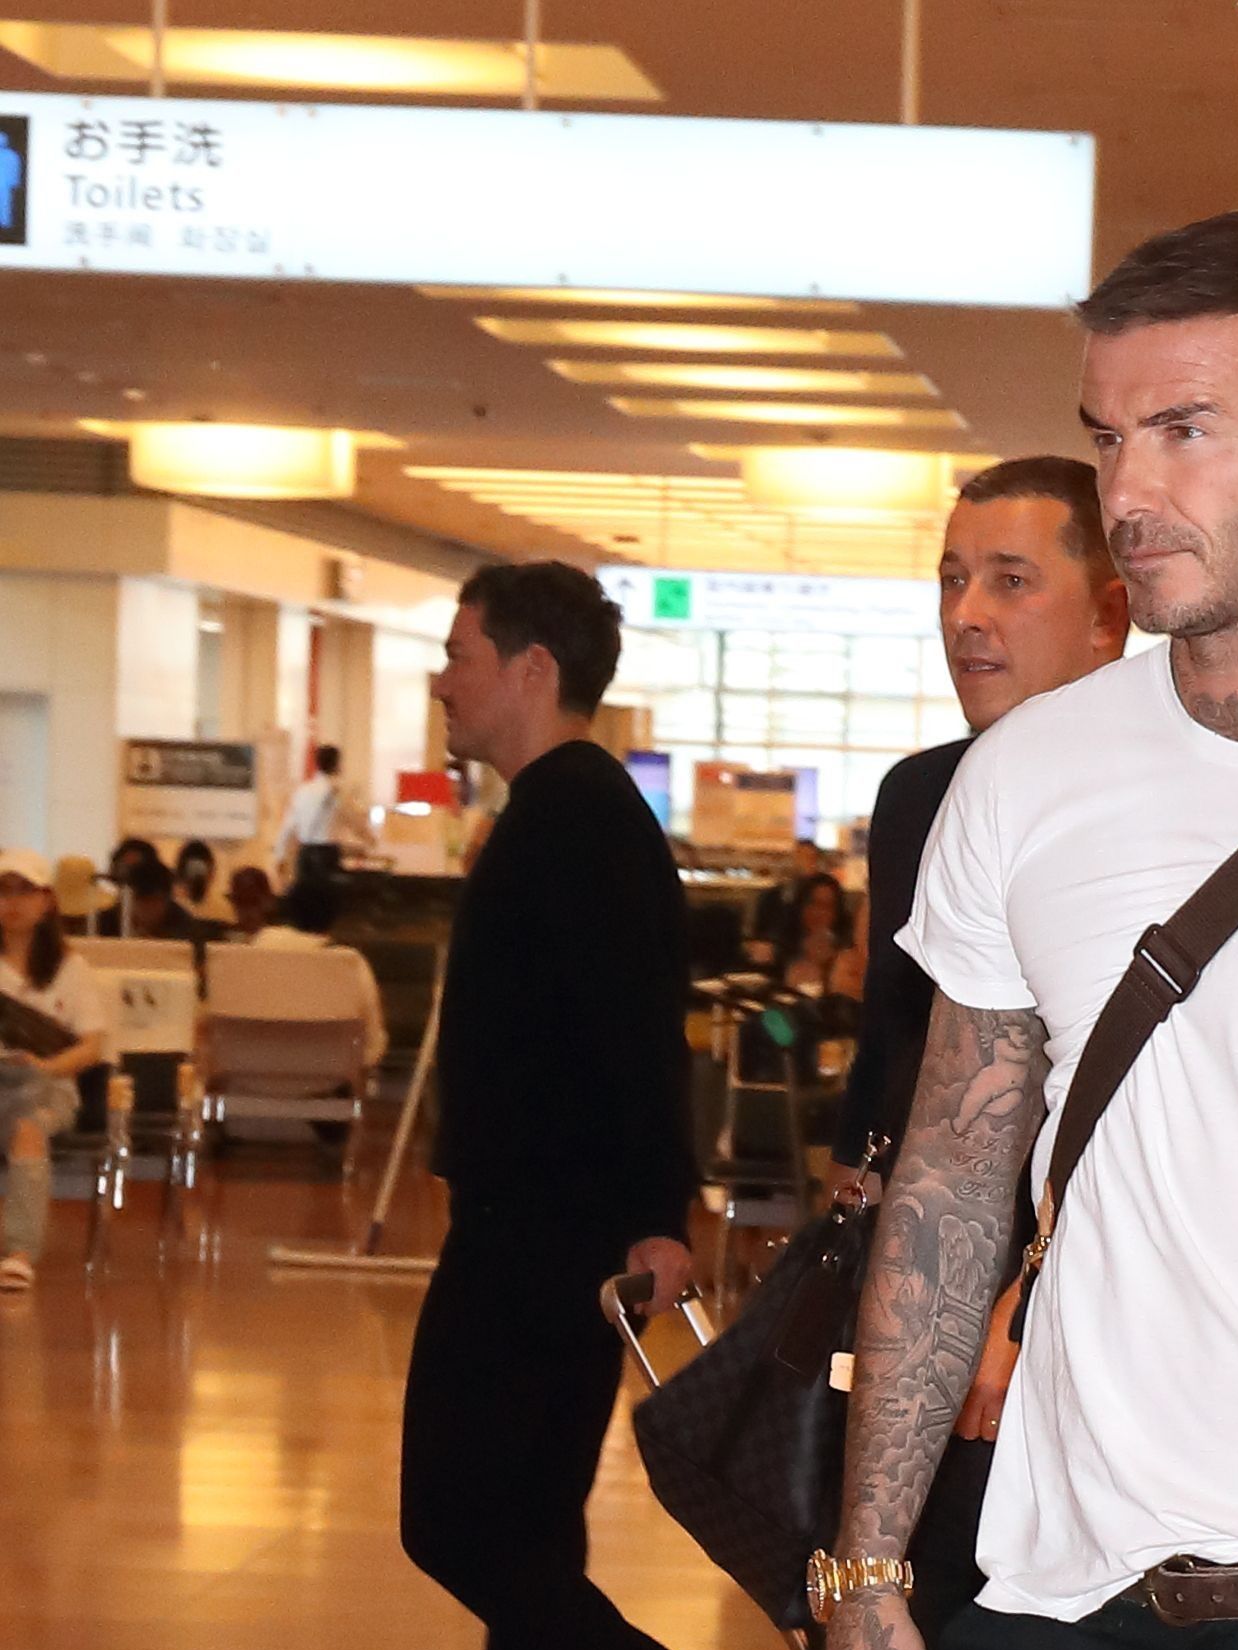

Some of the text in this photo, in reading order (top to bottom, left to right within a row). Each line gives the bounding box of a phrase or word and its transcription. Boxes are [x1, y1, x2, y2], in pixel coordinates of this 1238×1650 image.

[65, 120, 222, 167] お手洗
[66, 174, 204, 211] Toilets
